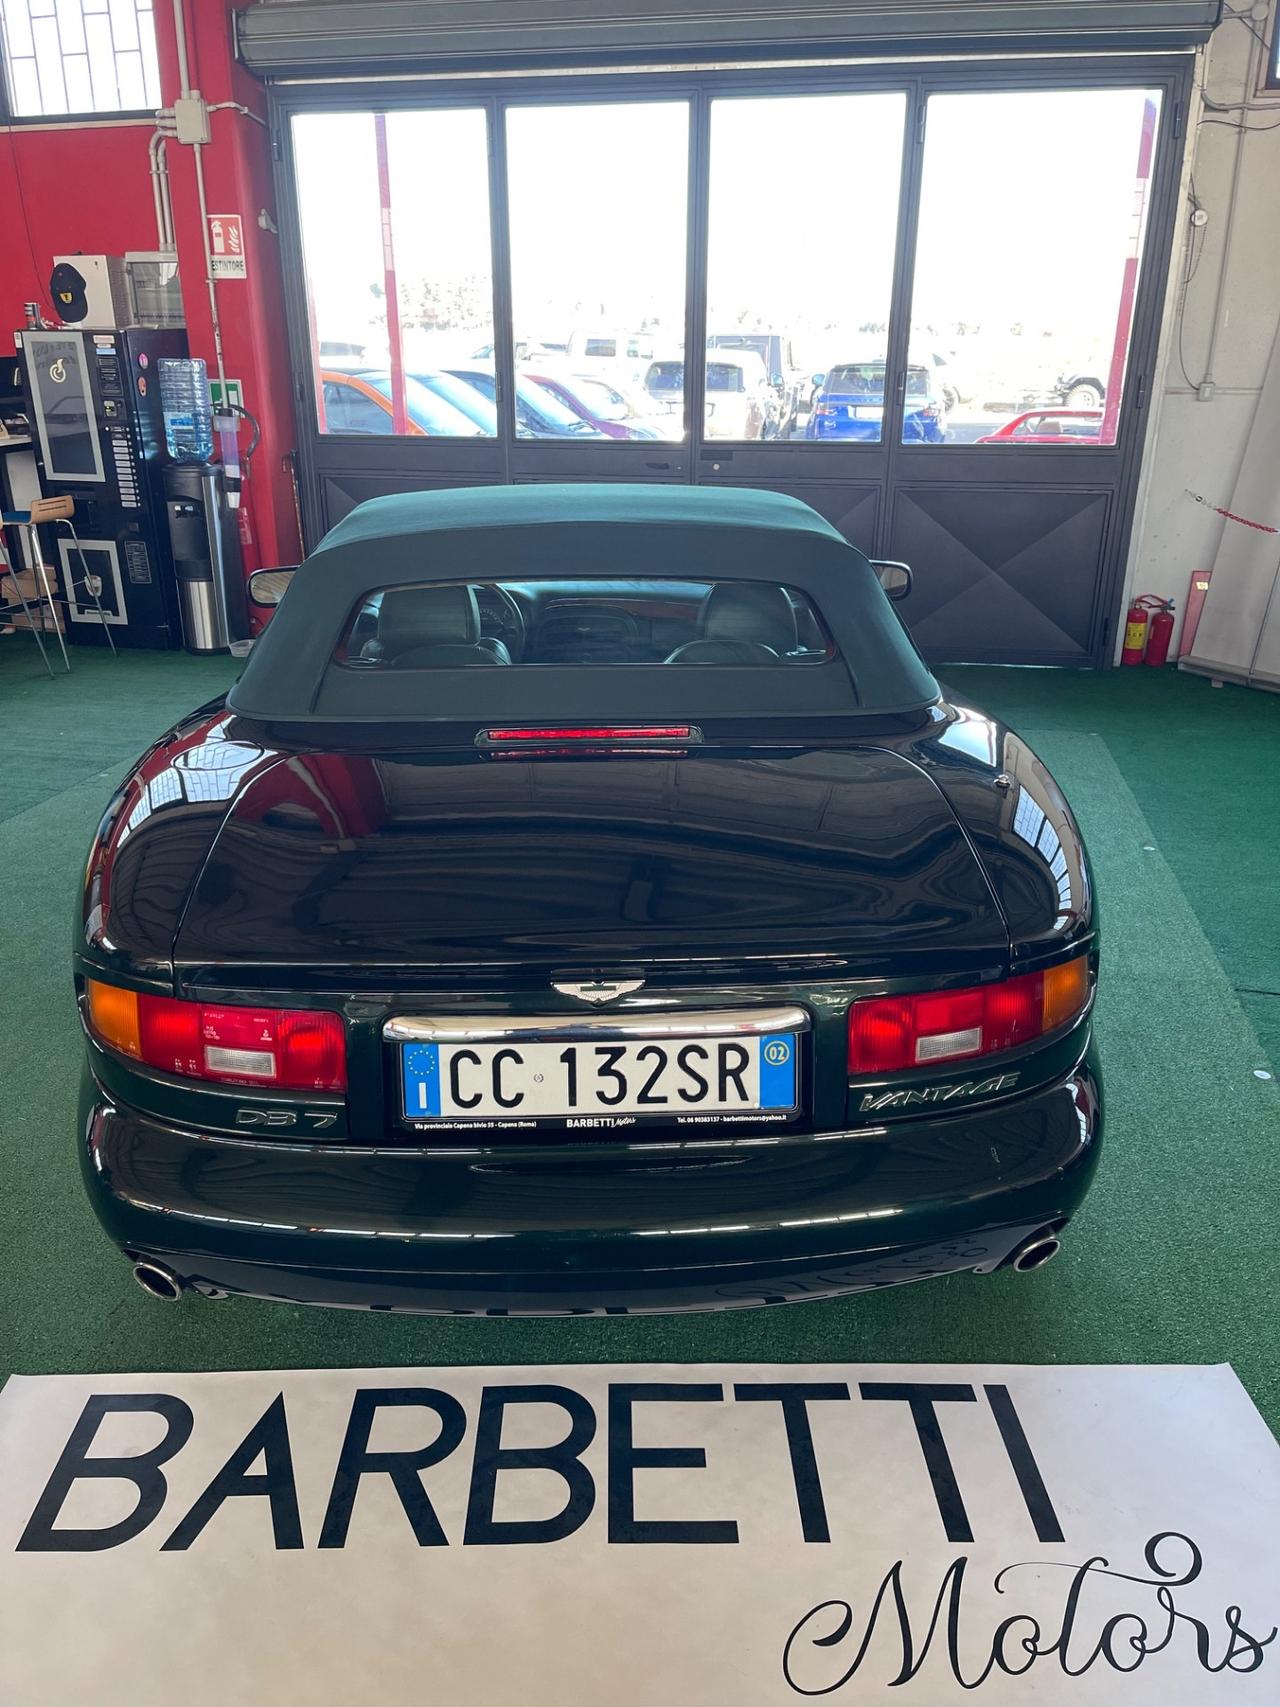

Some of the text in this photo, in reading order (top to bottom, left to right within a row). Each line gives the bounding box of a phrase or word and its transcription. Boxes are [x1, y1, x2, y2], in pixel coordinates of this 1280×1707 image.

[211, 259, 244, 272] ESTINTORE
[769, 1046, 785, 1060] 02
[449, 1043, 750, 1108] CC 132SR
[859, 1072, 1022, 1112] VANTAGE
[566, 1118, 614, 1128] BARBETTI
[14, 1383, 1066, 1552] BARBETTI
[782, 1532, 1278, 1696] Motors
